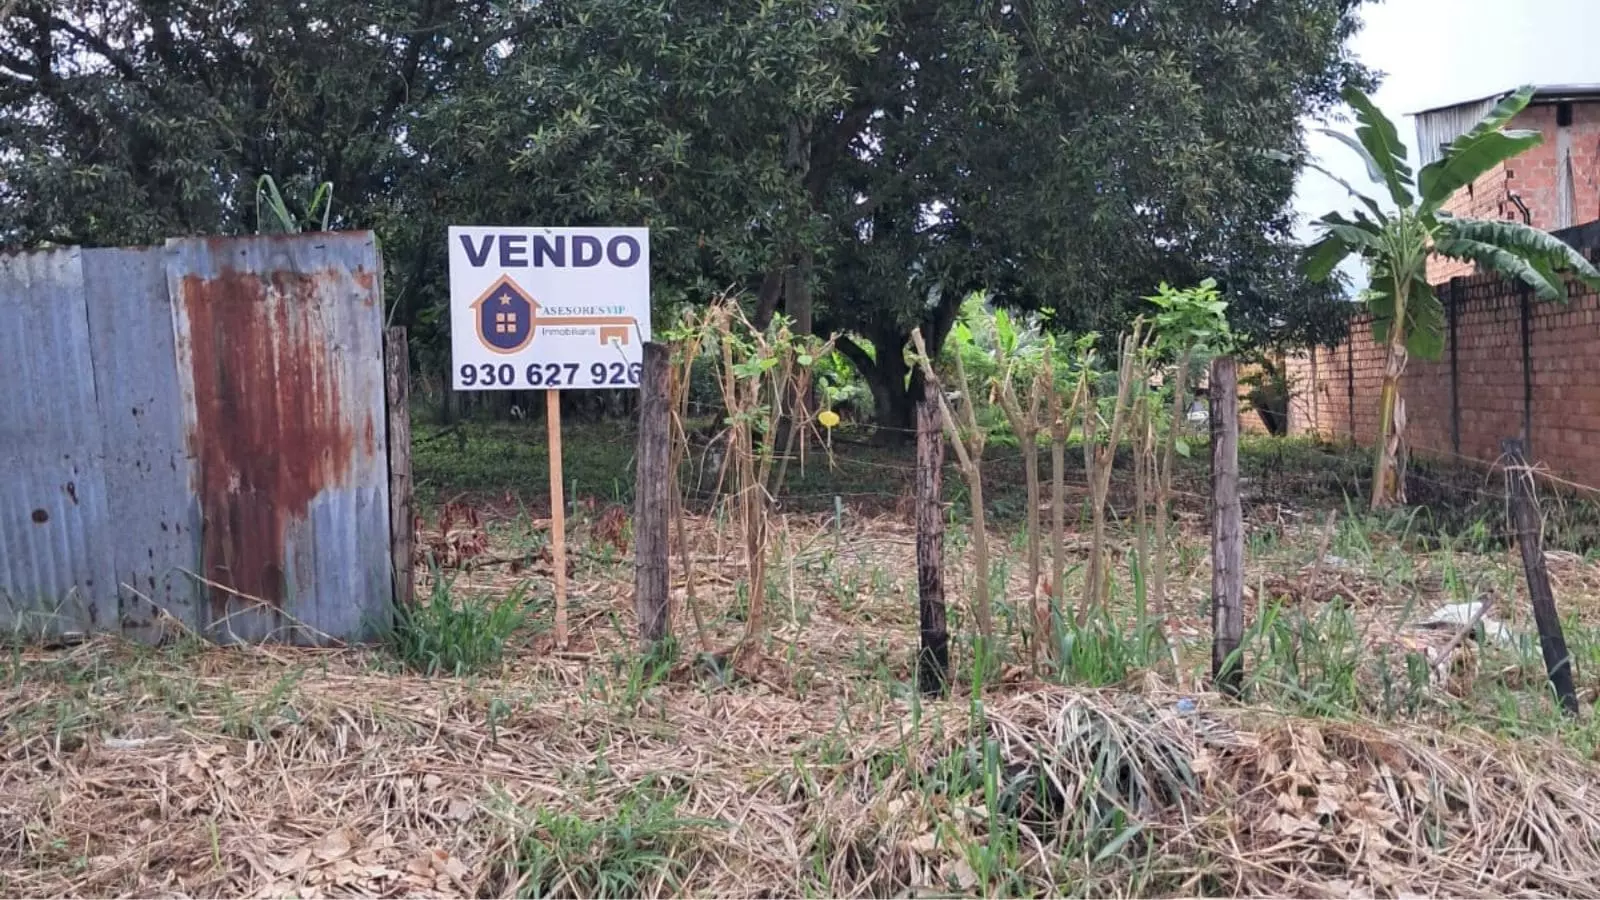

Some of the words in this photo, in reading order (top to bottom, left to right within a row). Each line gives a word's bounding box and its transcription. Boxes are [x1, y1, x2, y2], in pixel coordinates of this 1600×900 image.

[459, 234, 641, 268] VENDO
[460, 363, 515, 386] 930
[526, 362, 580, 386] 627
[590, 361, 643, 385] 926
